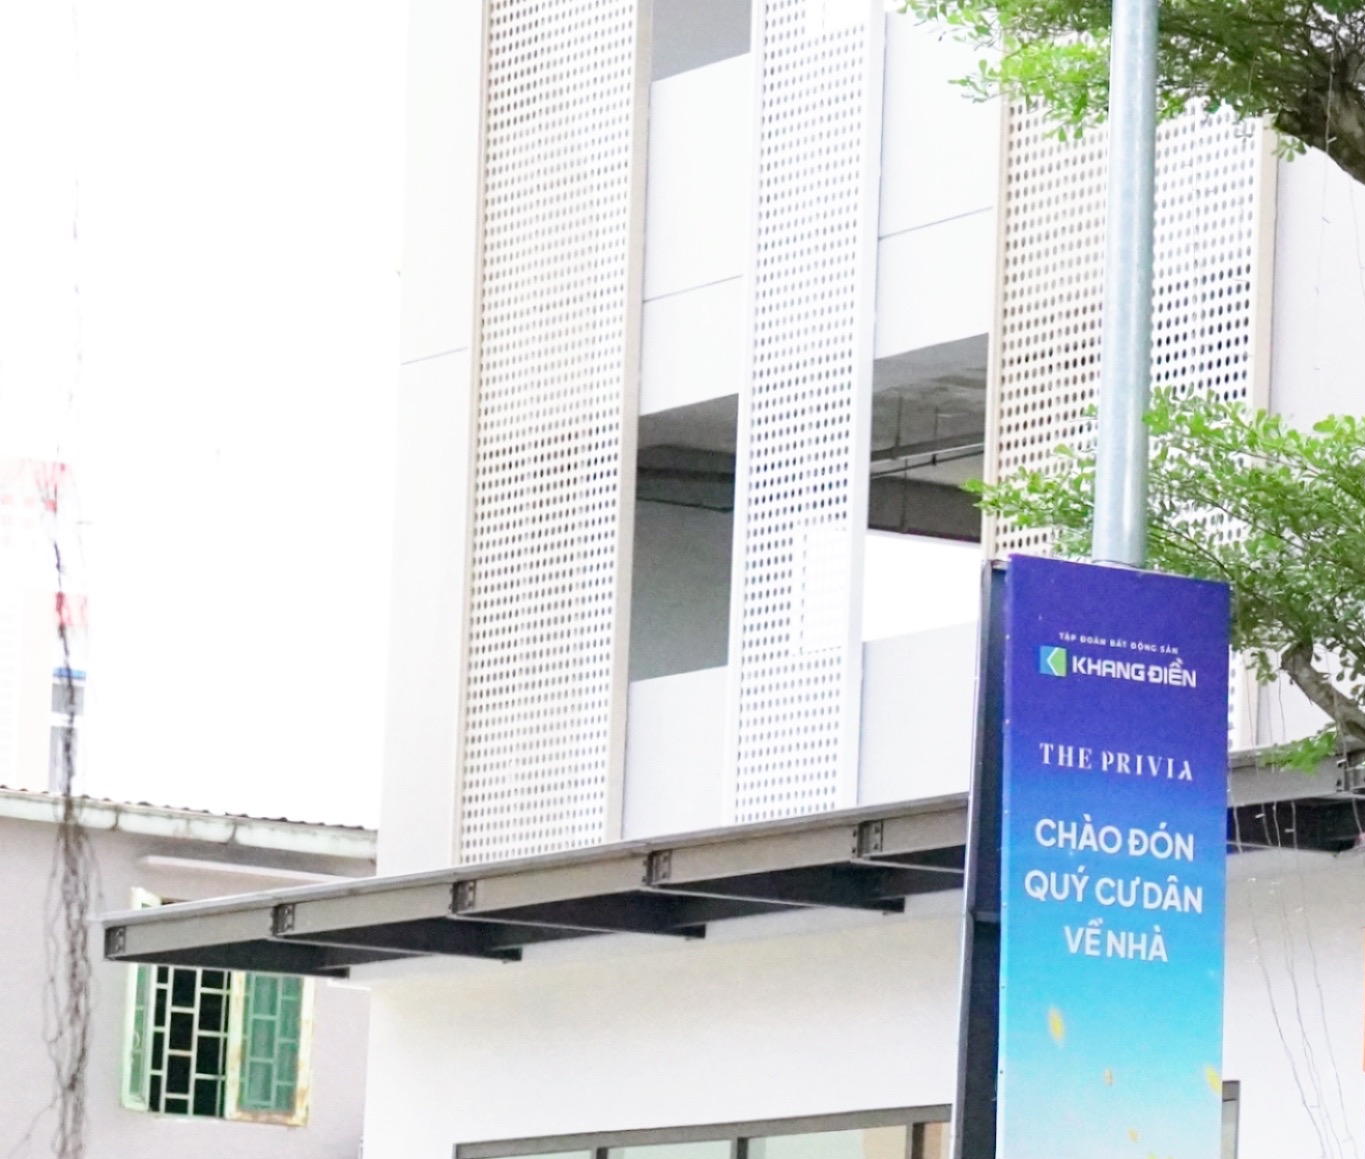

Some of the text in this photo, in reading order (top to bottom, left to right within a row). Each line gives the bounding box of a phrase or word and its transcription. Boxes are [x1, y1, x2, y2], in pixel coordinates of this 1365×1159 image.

[1072, 655, 1197, 688] KHANG ĐIỀN
[1039, 742, 1193, 781] THE PRIVIA
[1034, 813, 1195, 862] CHÀO ĐÓN
[1024, 865, 1203, 914] QUÝ CƯ DÂN
[1106, 924, 1169, 963] NHÀ
